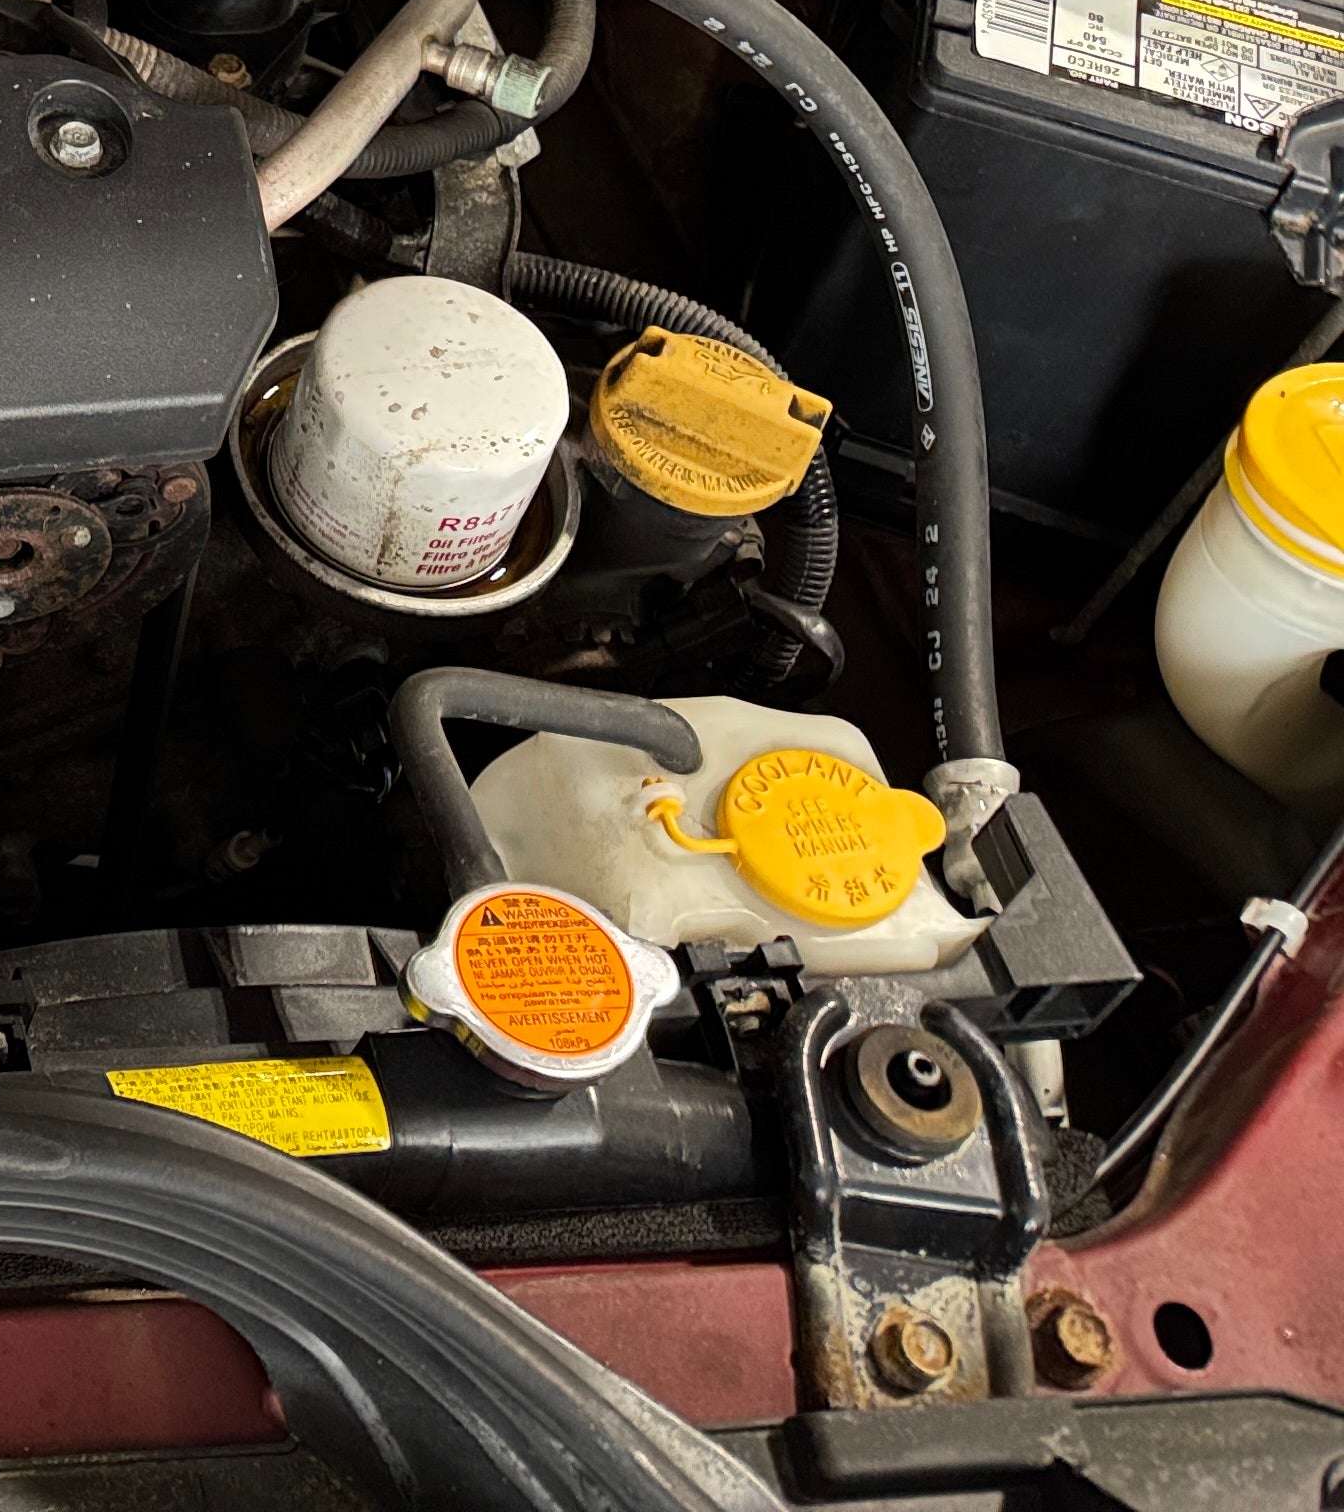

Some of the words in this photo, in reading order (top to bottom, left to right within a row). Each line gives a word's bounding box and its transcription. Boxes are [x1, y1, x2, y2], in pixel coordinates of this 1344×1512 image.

[1143, 55, 1162, 67] GET
[1144, 47, 1189, 67] MEDICAL
[1179, 47, 1202, 61] HELP
[785, 82, 818, 112] CJ
[1163, 76, 1235, 103] IMMEDIATELY
[829, 132, 886, 221] HFC-134a
[881, 228, 900, 254] HP
[904, 306, 930, 401] ANESIS
[609, 407, 637, 436] SEE
[702, 471, 770, 494] MANUAL
[429, 539, 453, 549] Oil
[457, 529, 500, 548] Filter
[925, 524, 939, 544] 2
[422, 551, 468, 562] Filtro
[473, 543, 491, 556] de
[415, 563, 462, 575] Filtre
[928, 630, 942, 671] CJ
[734, 755, 876, 814] COOLANT
[787, 797, 830, 817] SEE
[793, 835, 872, 858] MANUAL
[503, 907, 569, 920] WARNING
[469, 957, 507, 969] NEVER
[512, 955, 543, 967] OPEN
[546, 954, 581, 966] WHEN
[584, 953, 608, 964] HOT
[473, 970, 485, 979] NE
[490, 968, 526, 980] JAMAIS
[529, 966, 566, 978] OUVRIR
[508, 1010, 612, 1026] AVERTISSEMENT
[549, 1036, 590, 1049] 108kPa
[243, 1086, 279, 1098] STARTS
[283, 1082, 353, 1095] AUTOMATICALLY
[217, 1096, 276, 1112] VENTILATEUR
[221, 1111, 241, 1123] PAS
[245, 1110, 264, 1121] LES
